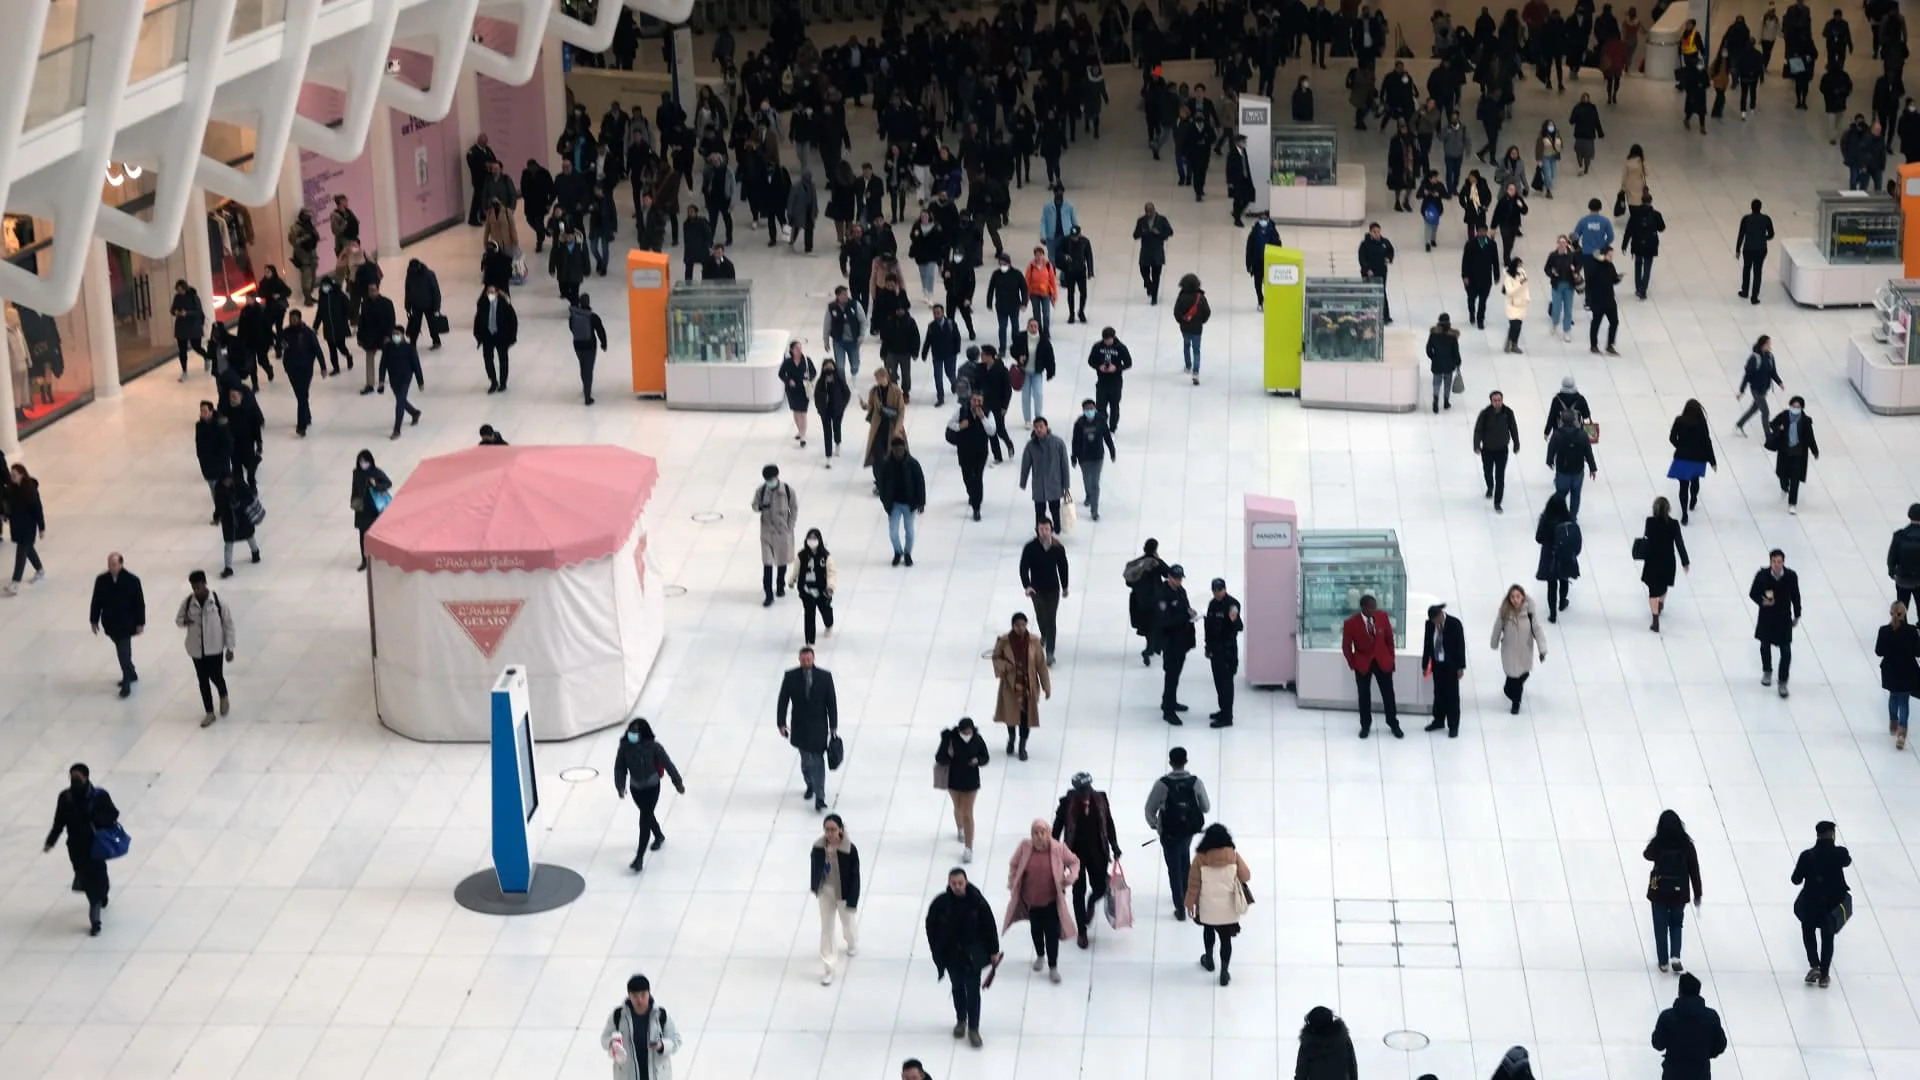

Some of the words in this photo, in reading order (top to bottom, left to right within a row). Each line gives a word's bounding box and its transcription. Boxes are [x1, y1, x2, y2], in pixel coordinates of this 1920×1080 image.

[435, 556, 469, 569] L'Arte
[470, 556, 488, 568] del
[489, 556, 525, 570] Gelato
[458, 606, 492, 616] L'Arte
[493, 606, 510, 615] del
[463, 616, 508, 625] GELATO
